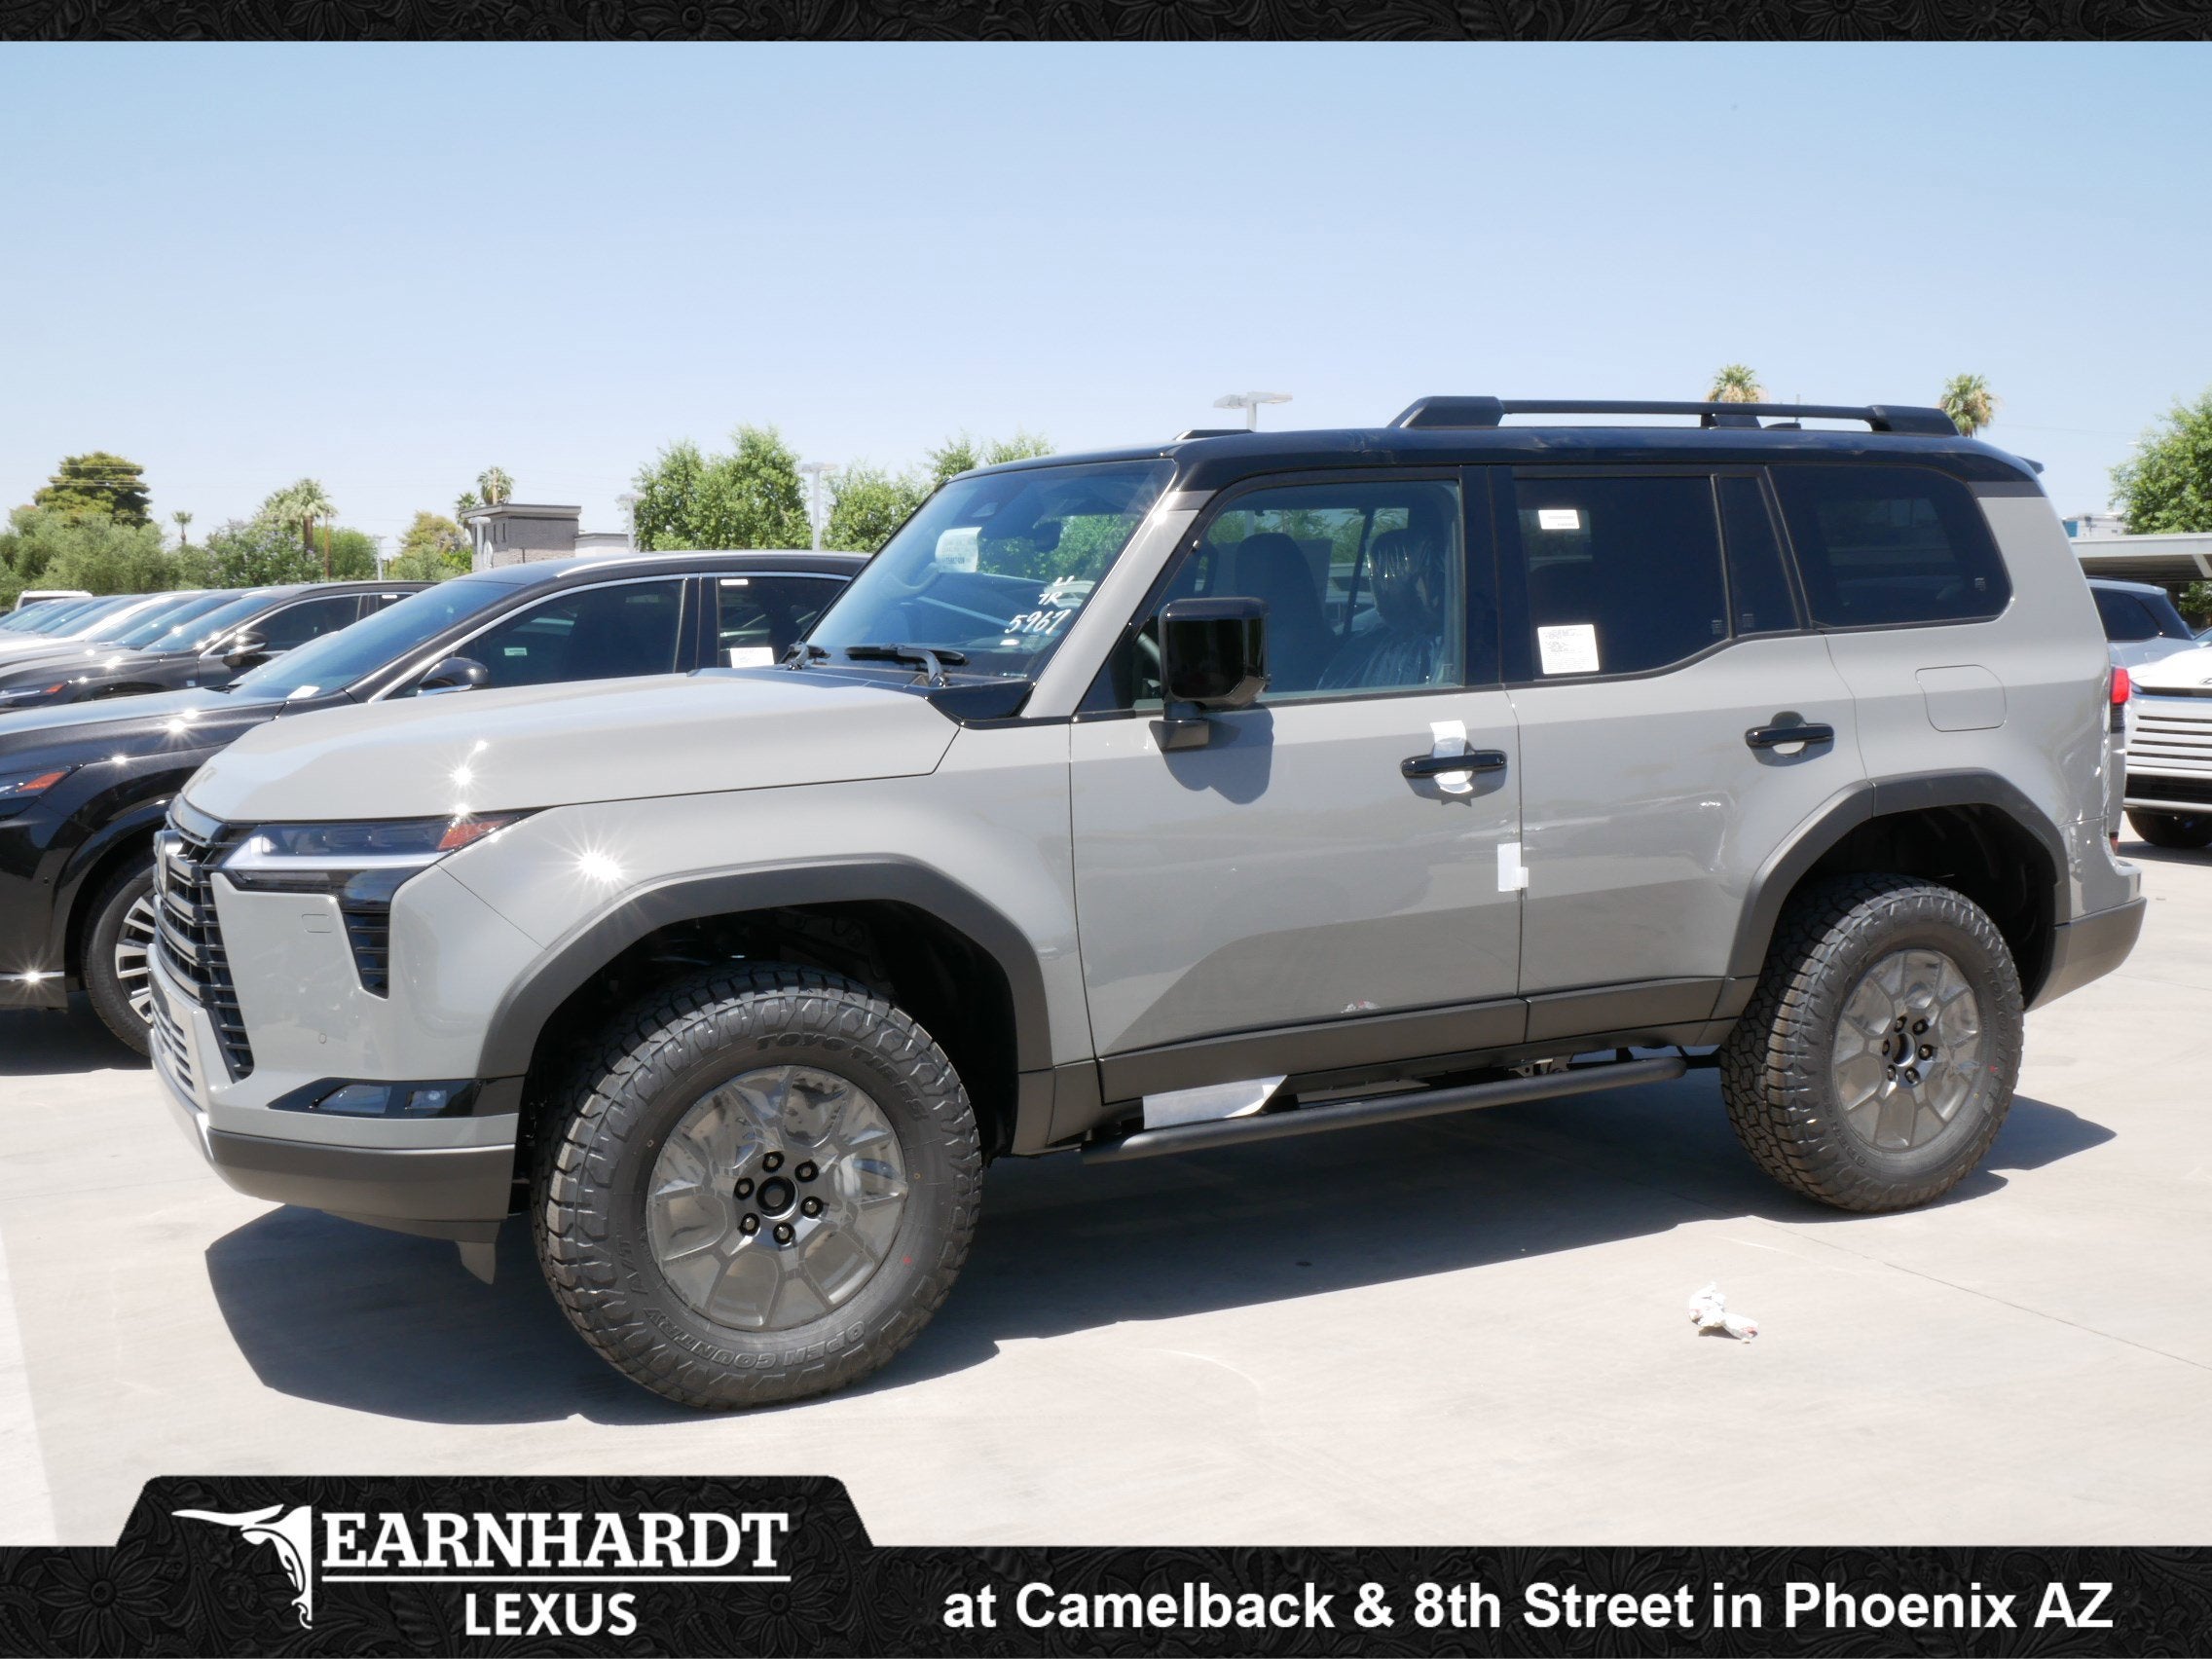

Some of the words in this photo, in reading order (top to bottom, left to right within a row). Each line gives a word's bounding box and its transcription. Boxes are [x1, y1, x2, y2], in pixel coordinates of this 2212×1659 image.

[1004, 608, 1072, 635] 5967
[756, 1031, 848, 1051] TOYO
[643, 1308, 777, 1370] COUNTRY
[783, 1320, 866, 1367] OPEN
